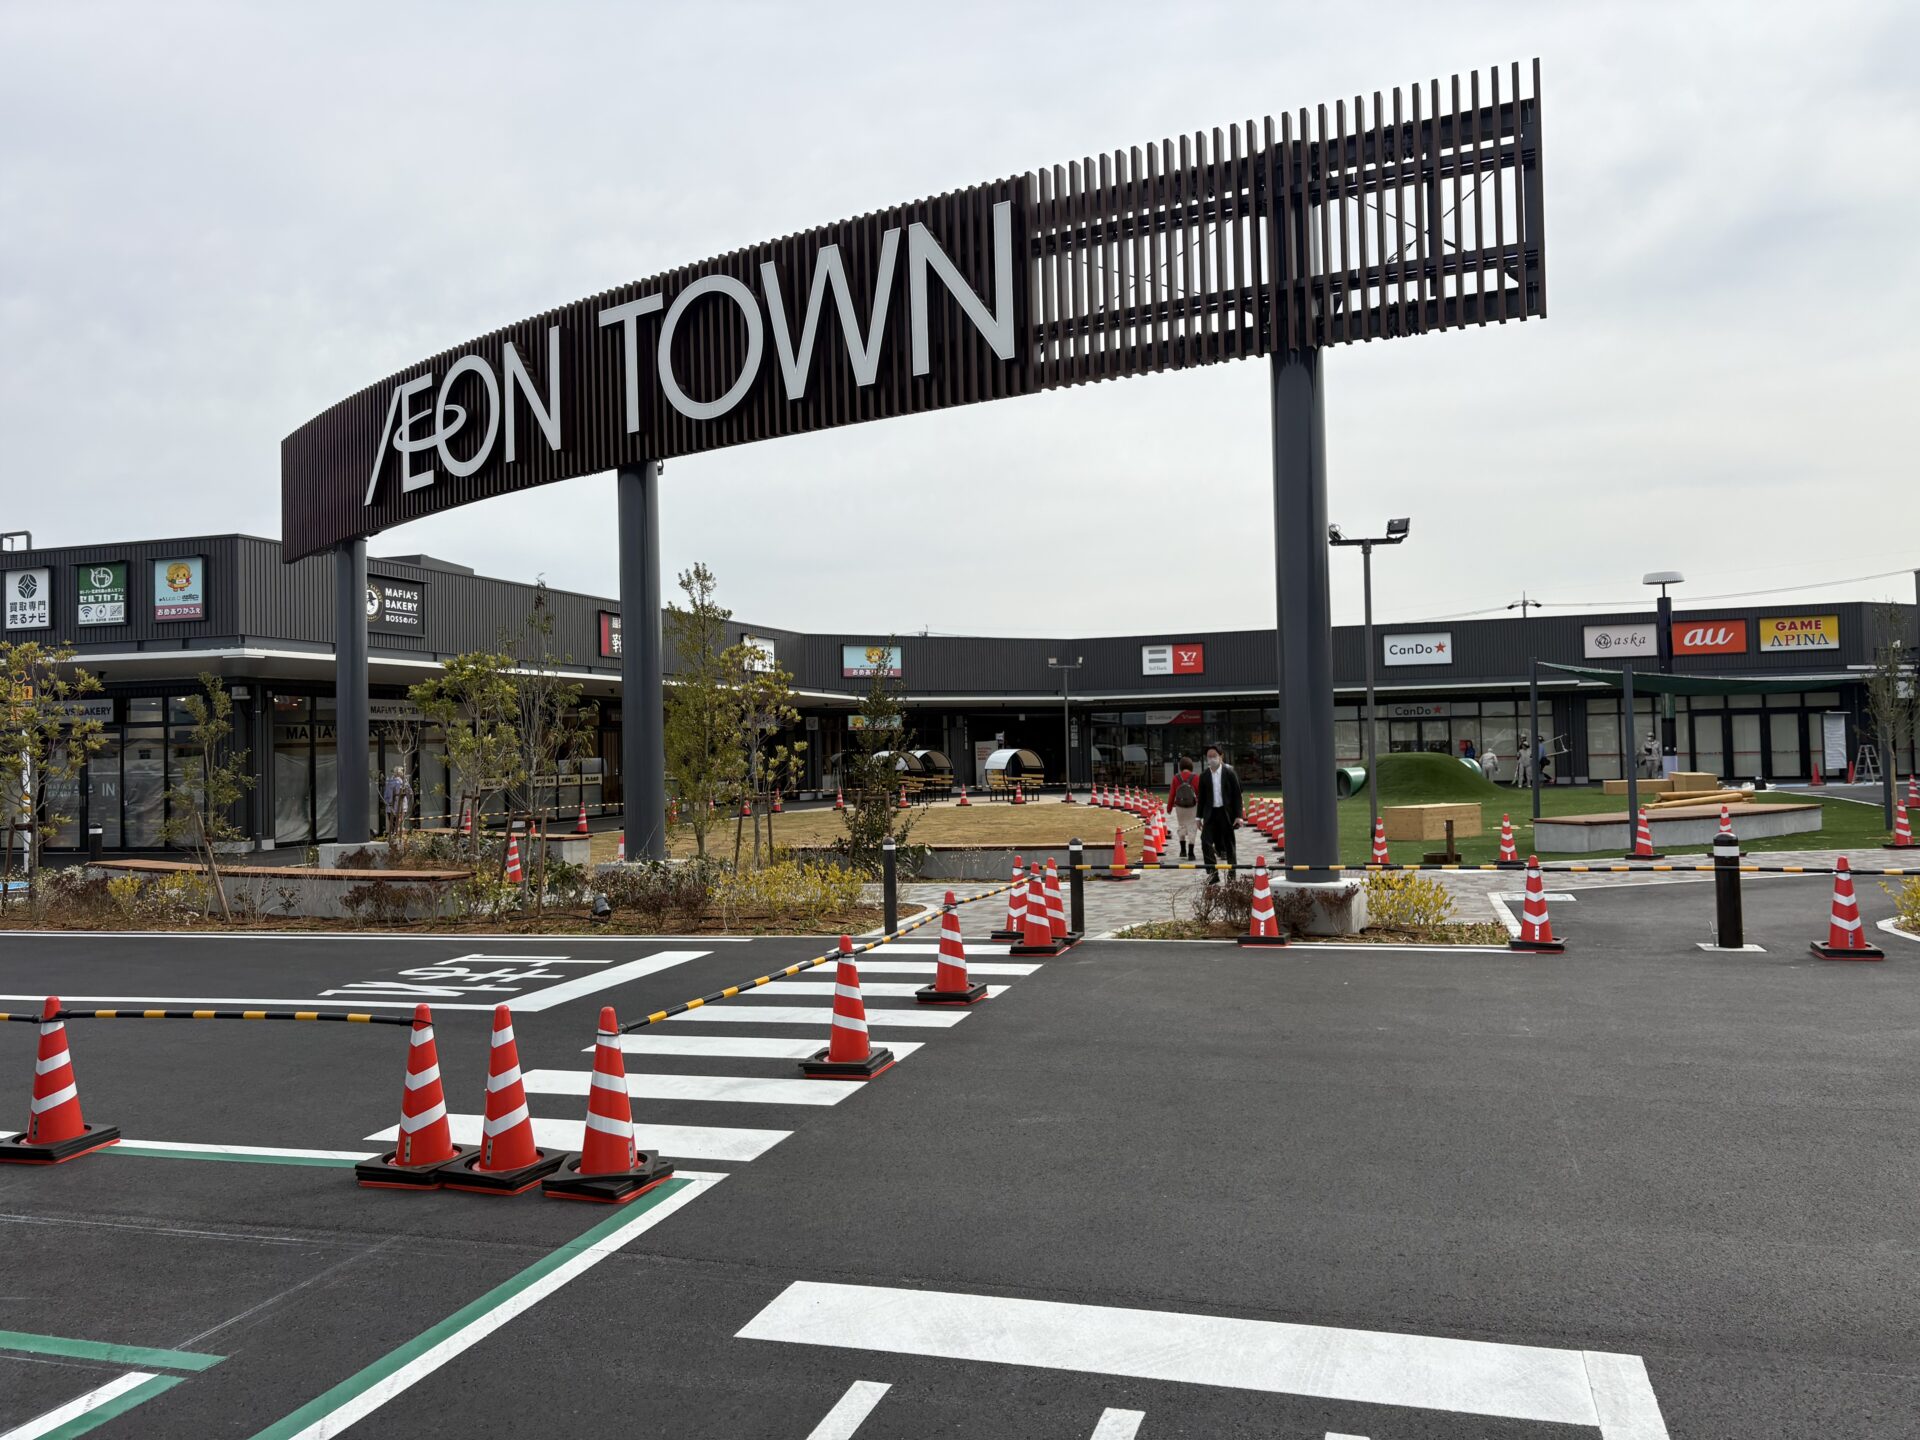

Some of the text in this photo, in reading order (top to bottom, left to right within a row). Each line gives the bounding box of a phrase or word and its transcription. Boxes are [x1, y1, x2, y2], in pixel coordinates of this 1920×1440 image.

[600, 200, 1015, 435] TOWN
[79, 593, 124, 603] セルフカフェ
[385, 587, 418, 600] MAFIA'S
[9, 600, 46, 613] 買取専門
[385, 599, 418, 612] BAKERY
[9, 613, 46, 625] 売るナビ
[1775, 619, 1822, 632] GAME
[1682, 627, 1734, 647] au
[1389, 642, 1433, 656] CanDo
[1395, 706, 1431, 716] CanDo
[102, 783, 116, 797] IN
